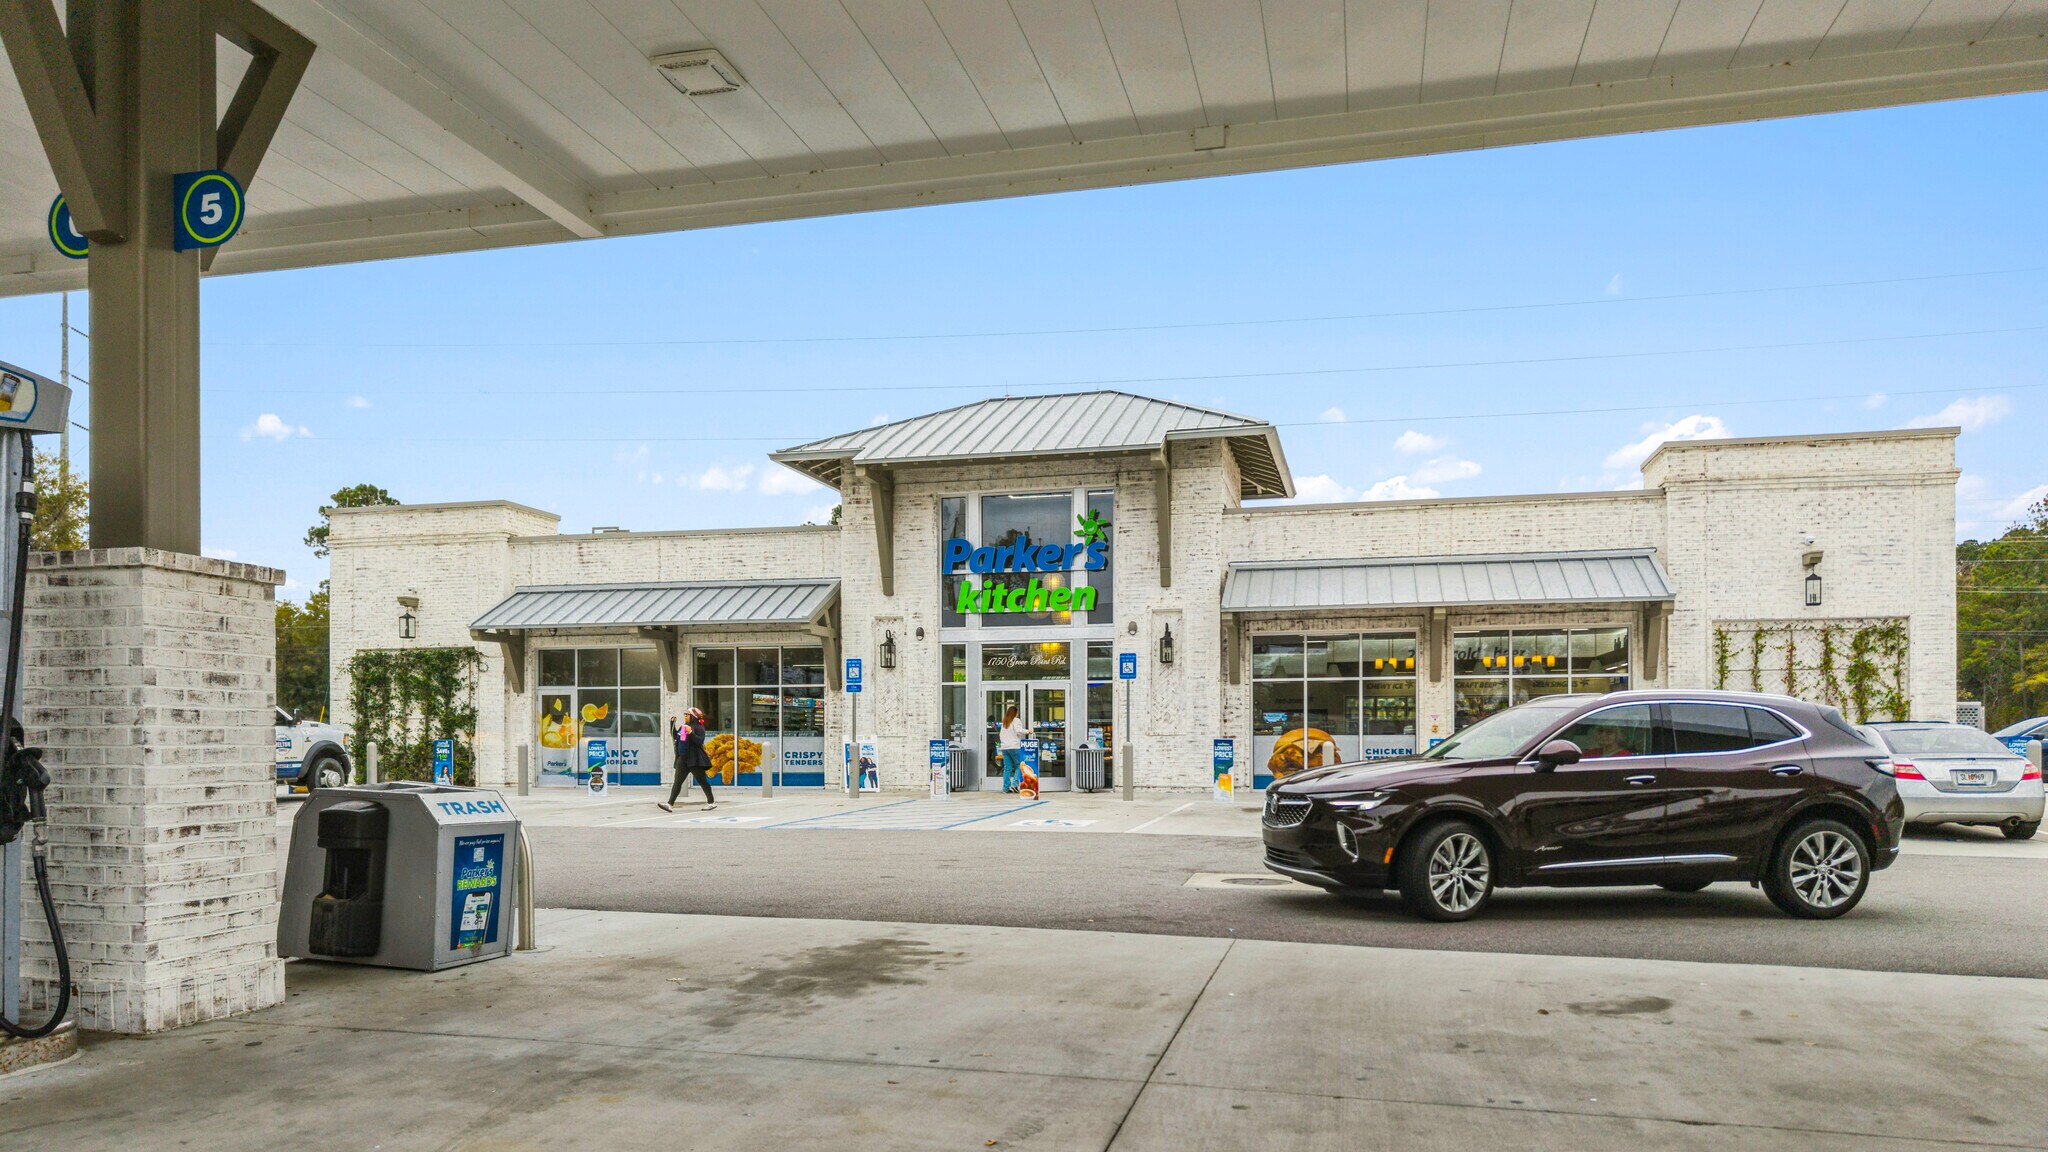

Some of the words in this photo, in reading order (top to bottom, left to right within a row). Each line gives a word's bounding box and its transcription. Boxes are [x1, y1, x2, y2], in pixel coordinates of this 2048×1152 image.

[199, 192, 223, 225] 5
[956, 578, 1096, 614] kitchen
[987, 657, 1007, 666] 1750
[1007, 653, 1028, 668] Grove
[1029, 653, 1051, 666] Point
[606, 749, 639, 758] ANCY
[784, 751, 823, 759] CRISPY
[436, 800, 505, 816] TRASH
[456, 876, 497, 891] REWARDS
